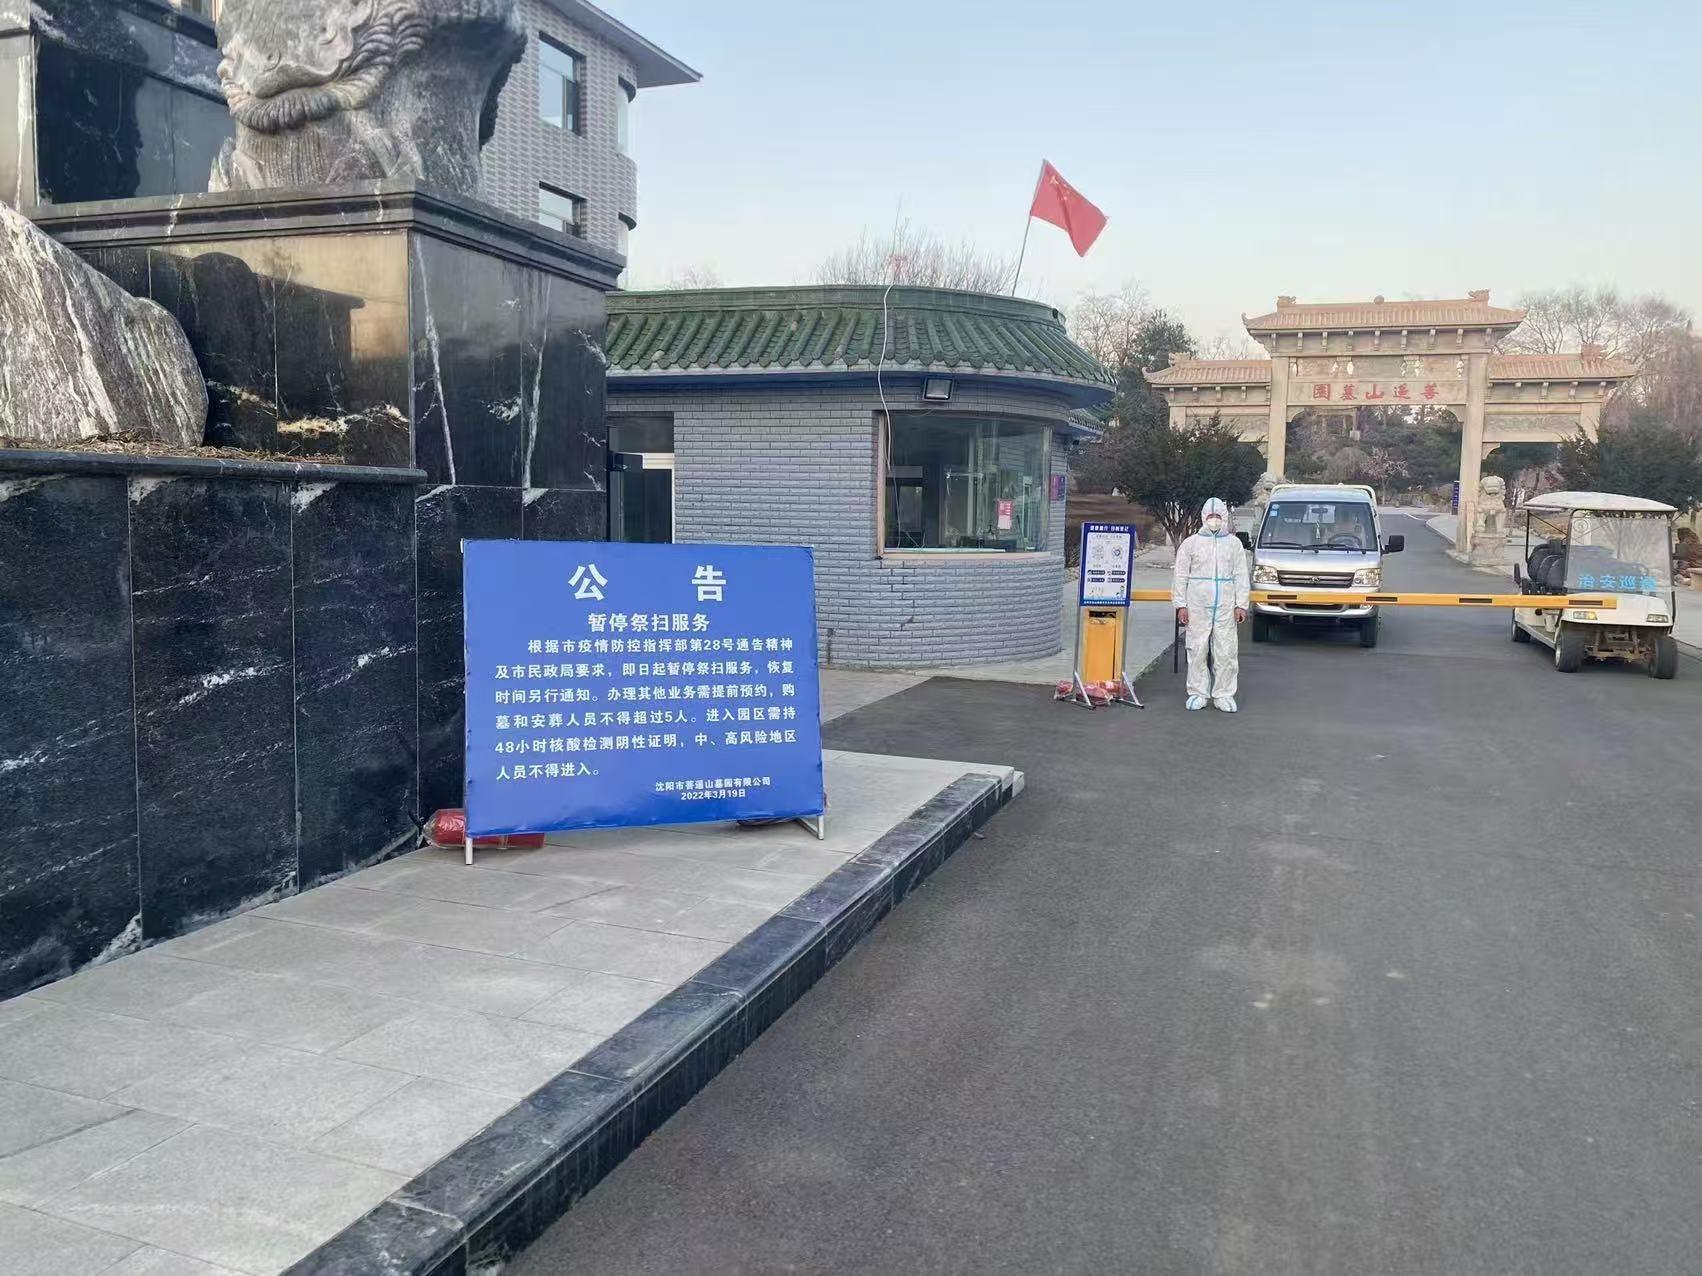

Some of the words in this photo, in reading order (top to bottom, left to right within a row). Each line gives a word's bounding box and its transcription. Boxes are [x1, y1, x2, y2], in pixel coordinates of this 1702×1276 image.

[567, 563, 727, 602] 公告
[587, 612, 710, 633] 暂停祭扫服务
[527, 638, 793, 654] 根据市疫情防控指挥部第28号通告精神
[495, 762, 600, 781] 人员不得进入。
[680, 788, 746, 801] 2022年3月19日
